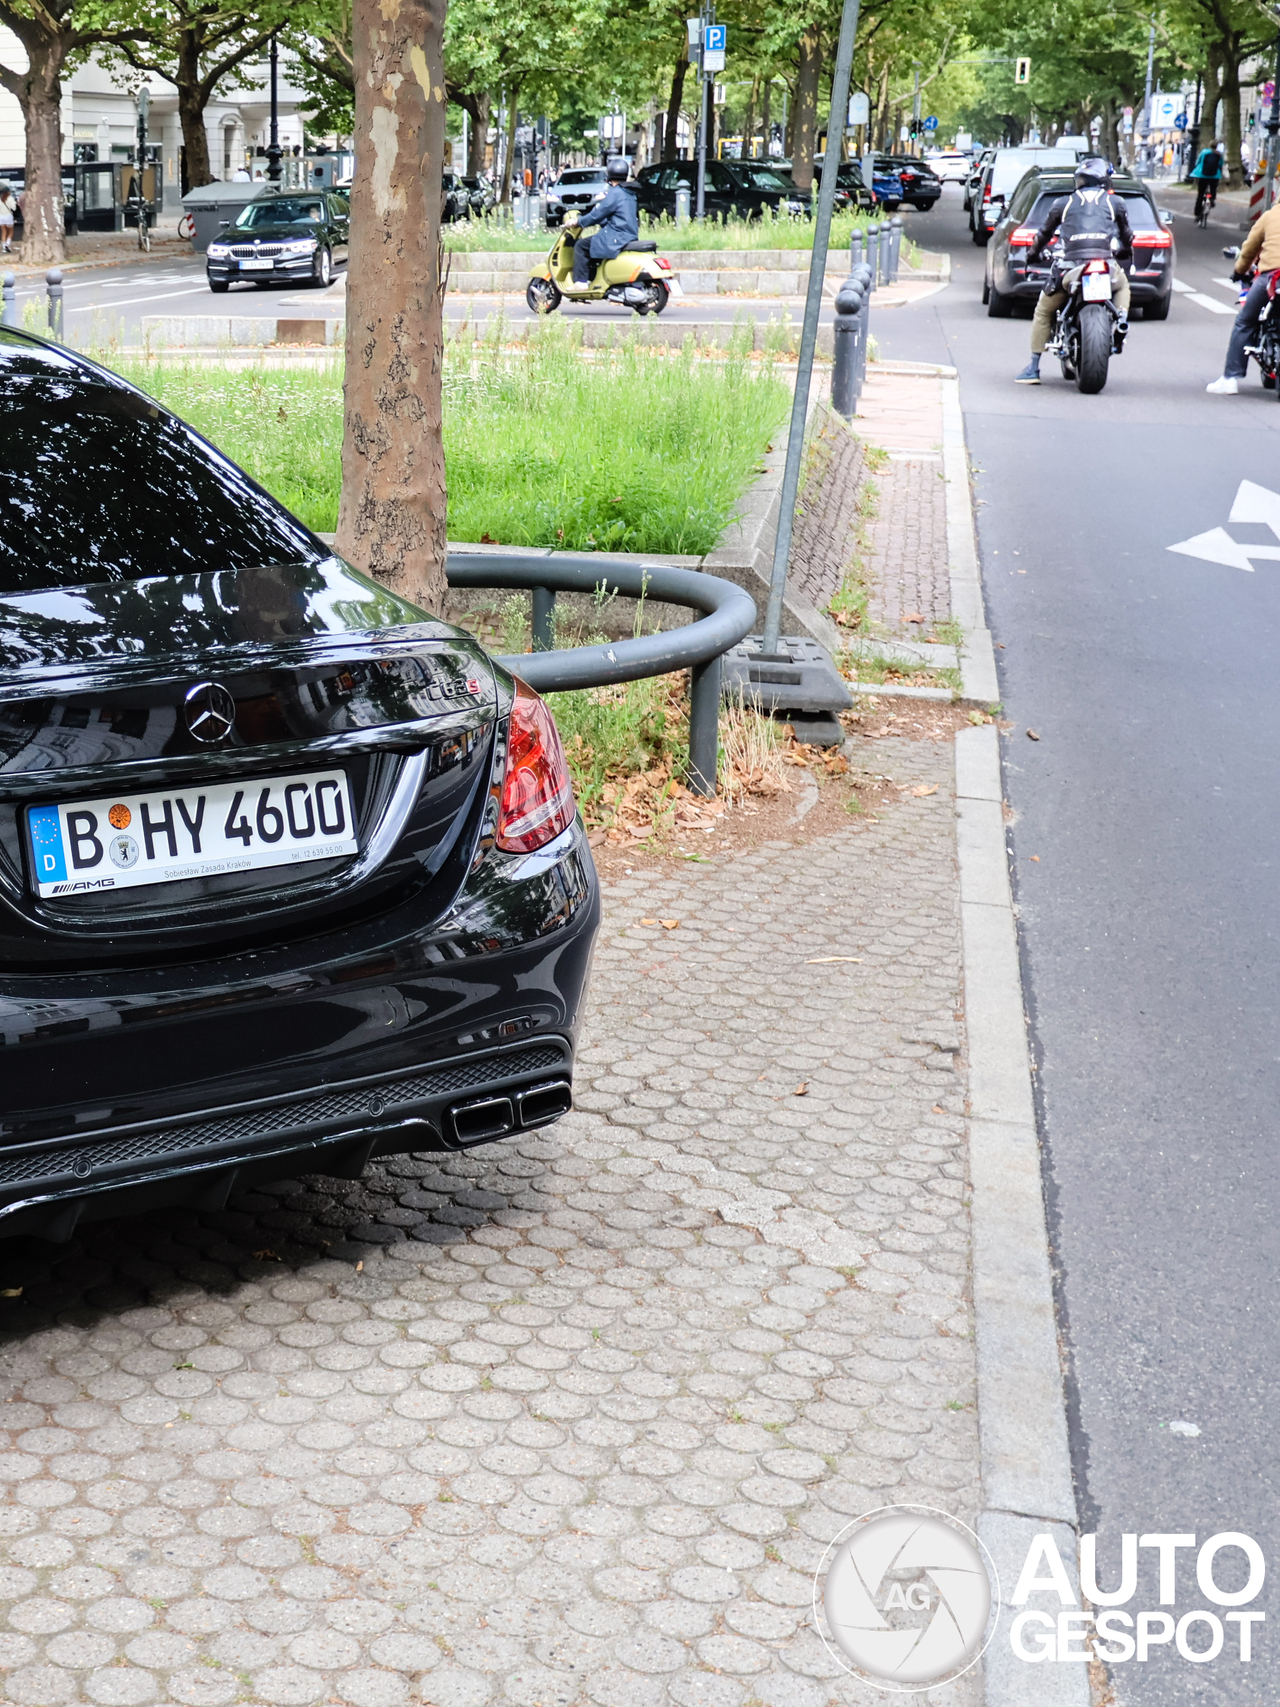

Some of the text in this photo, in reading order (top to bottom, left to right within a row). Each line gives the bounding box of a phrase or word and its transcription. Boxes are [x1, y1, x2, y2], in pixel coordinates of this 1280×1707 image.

[66, 779, 346, 869] B HY 4600
[291, 845, 343, 860] tel. 12 639 55 00
[44, 854, 56, 871] D
[164, 859, 251, 879] Sobiesław Zasada Kraków
[73, 877, 115, 891] AMG
